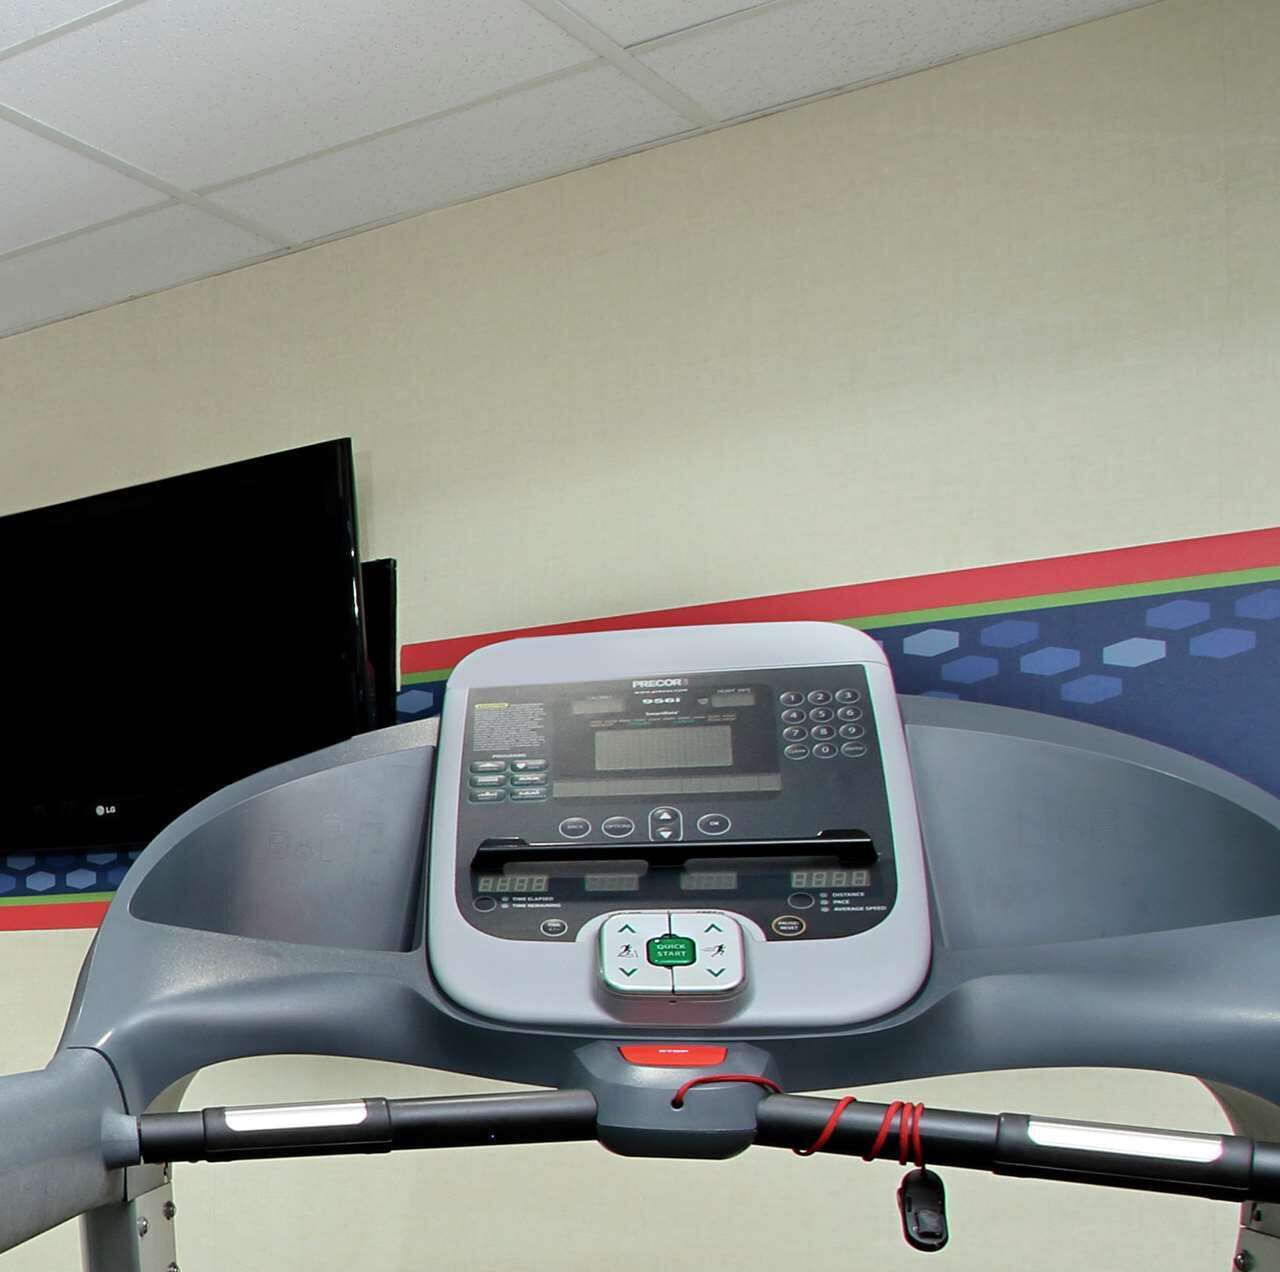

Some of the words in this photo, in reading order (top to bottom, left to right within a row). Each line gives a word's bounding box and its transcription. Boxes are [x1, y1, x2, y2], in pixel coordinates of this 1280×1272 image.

[632, 678, 681, 688] PRECOR
[844, 691, 852, 699] 3
[790, 711, 798, 719] 4
[818, 710, 826, 718] 5
[848, 726, 856, 734] 9
